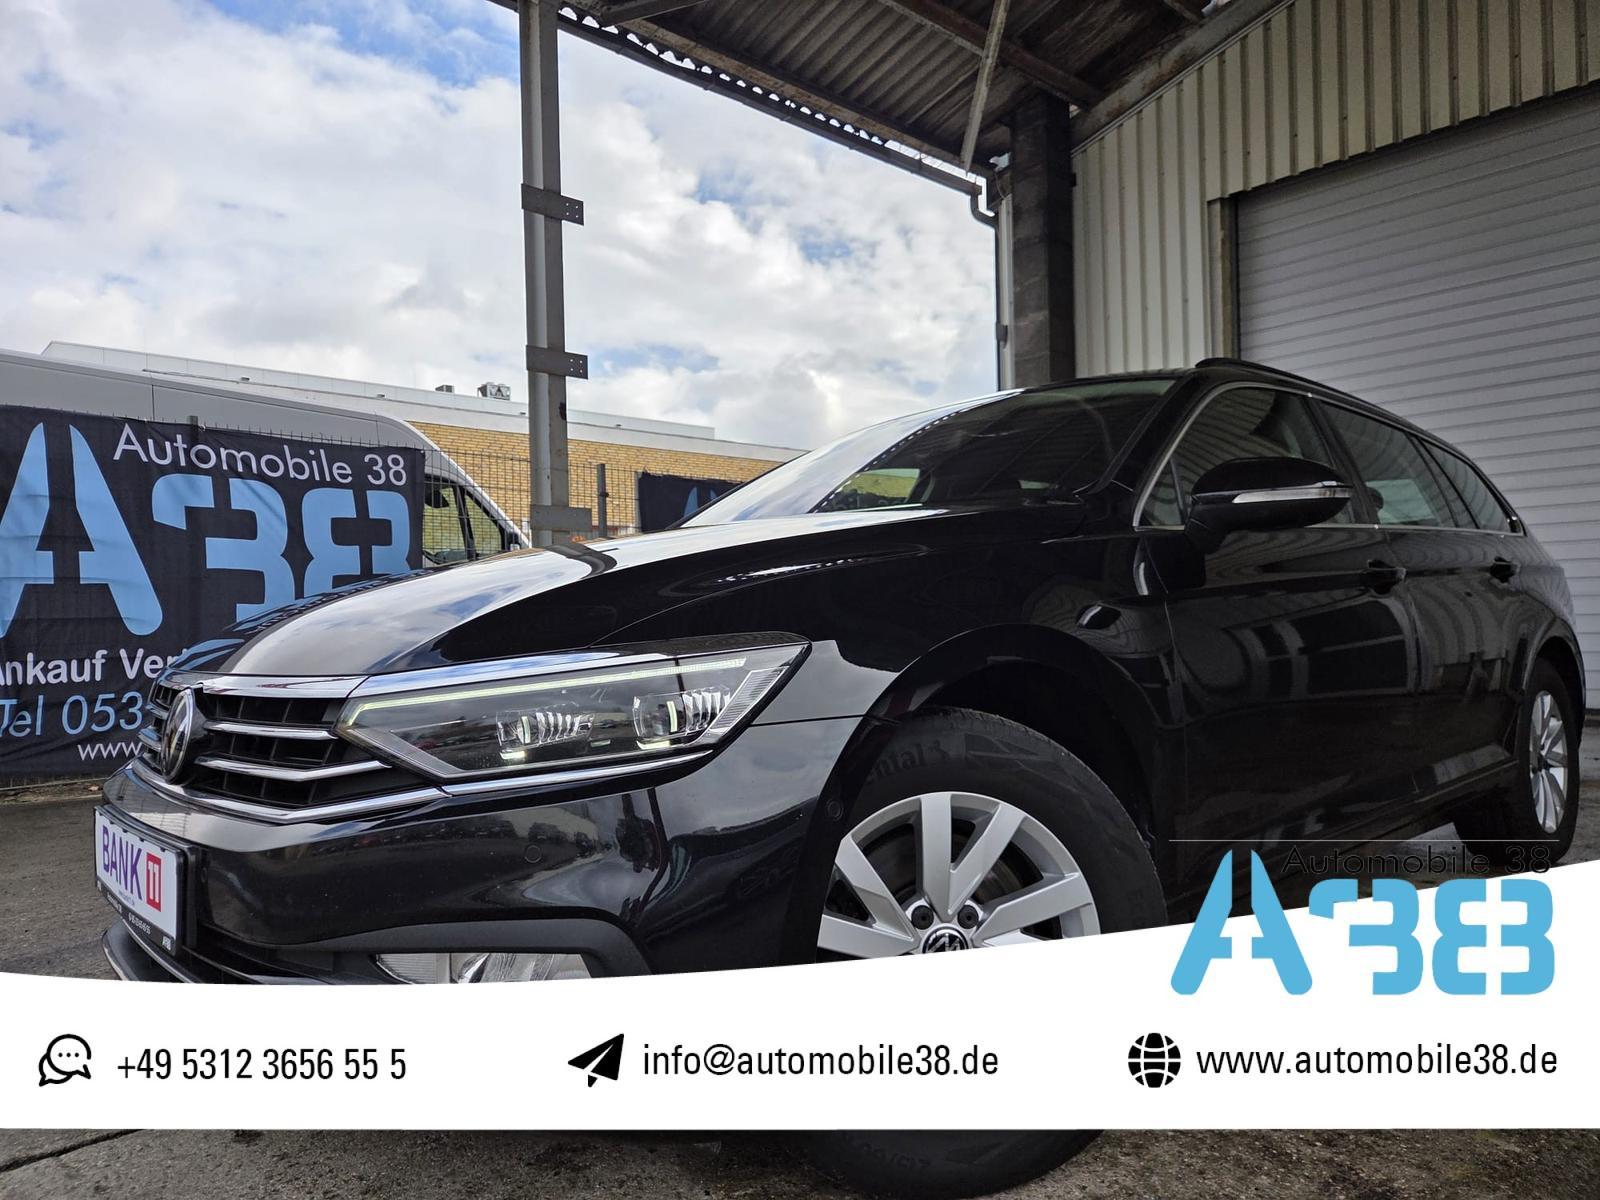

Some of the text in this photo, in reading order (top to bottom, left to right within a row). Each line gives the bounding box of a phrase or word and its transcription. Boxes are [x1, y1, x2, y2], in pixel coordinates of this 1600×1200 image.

[113, 423, 408, 487] Automobile 38
[0, 421, 411, 637] A38
[62, 691, 143, 736] 053
[102, 825, 161, 908] BANK 11
